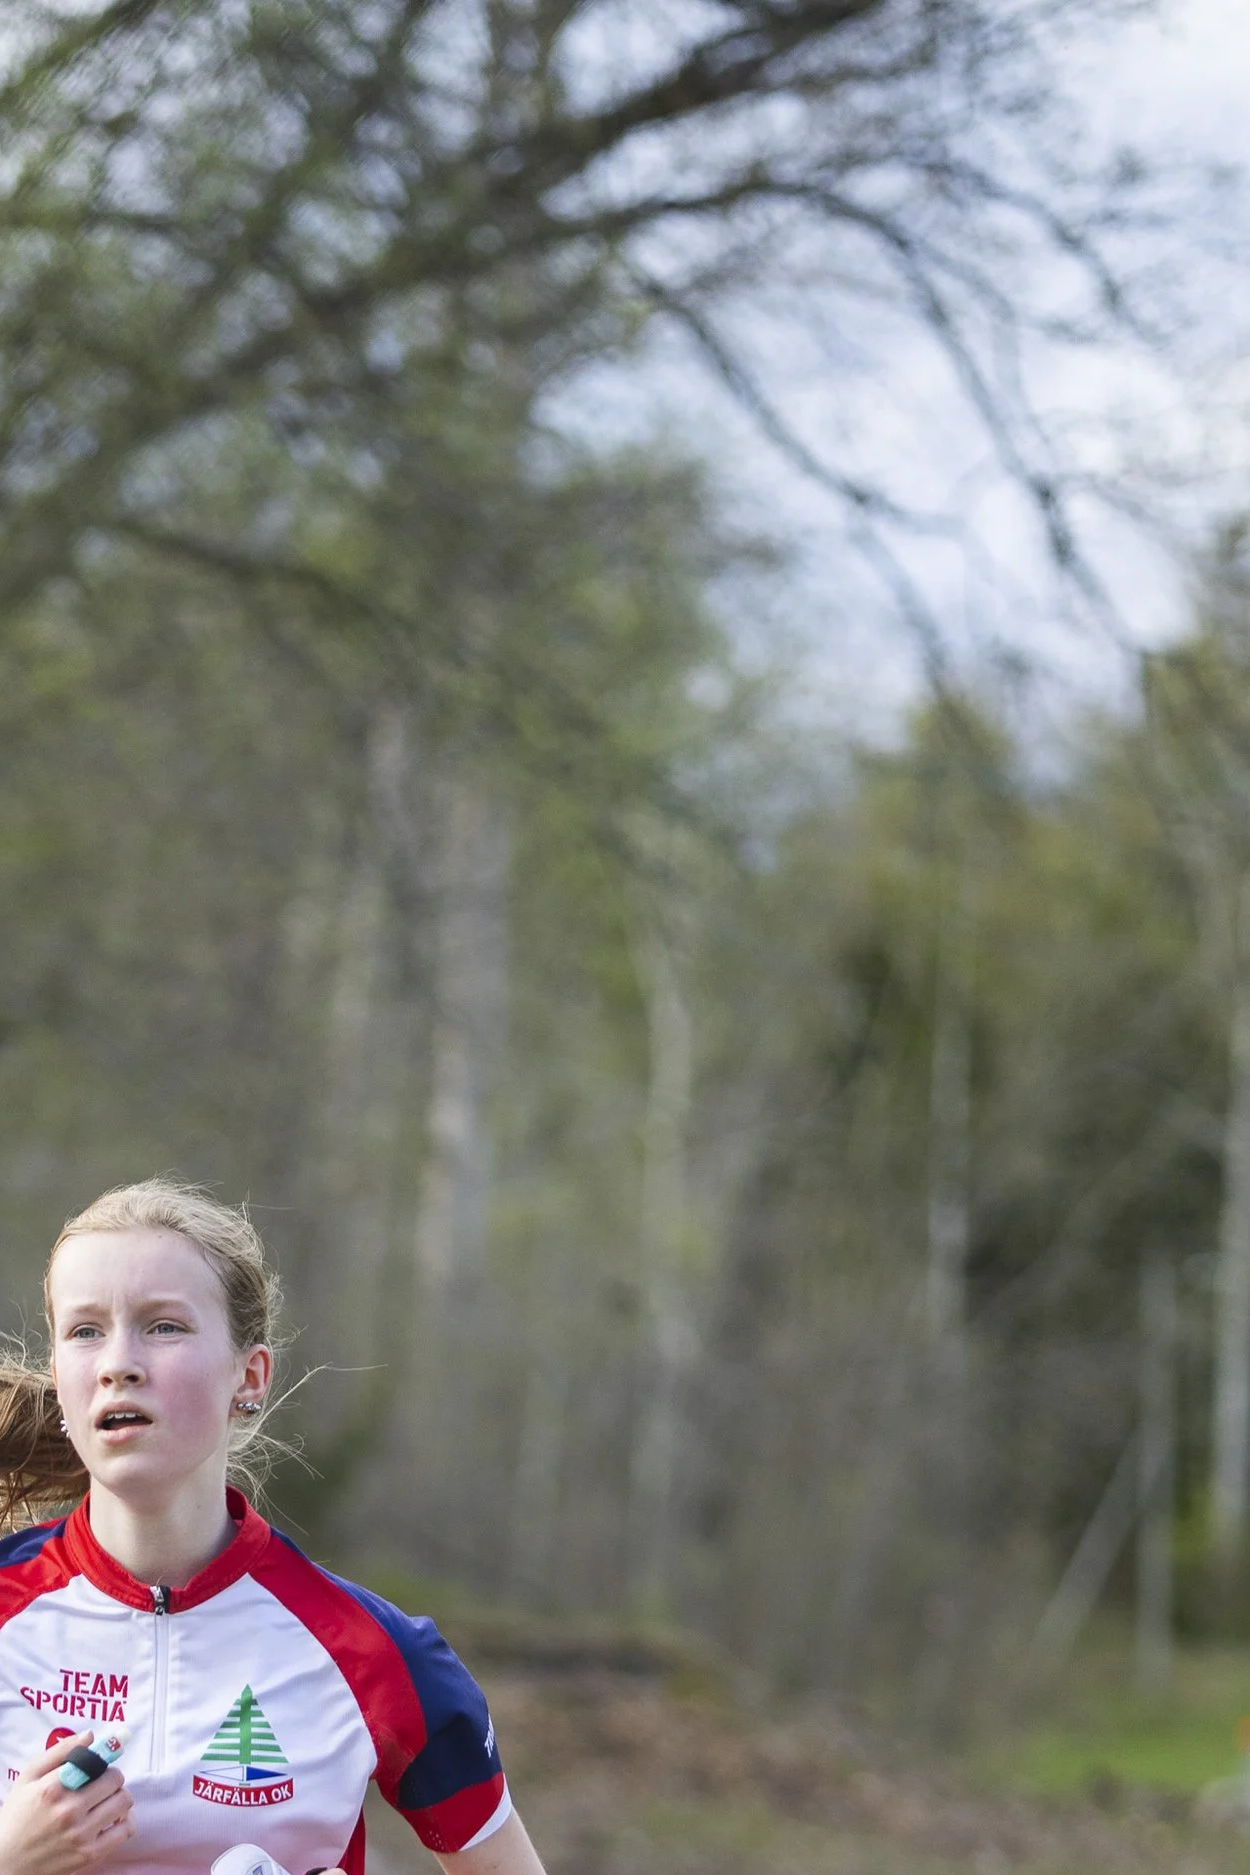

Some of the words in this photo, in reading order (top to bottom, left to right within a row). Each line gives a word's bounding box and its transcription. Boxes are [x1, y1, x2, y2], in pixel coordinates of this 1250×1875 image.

[59, 1668, 129, 1698] TEAM
[19, 1686, 127, 1722] SPORTIA
[194, 1781, 268, 1805] JÄRFÄLLA
[271, 1784, 292, 1801] OK
